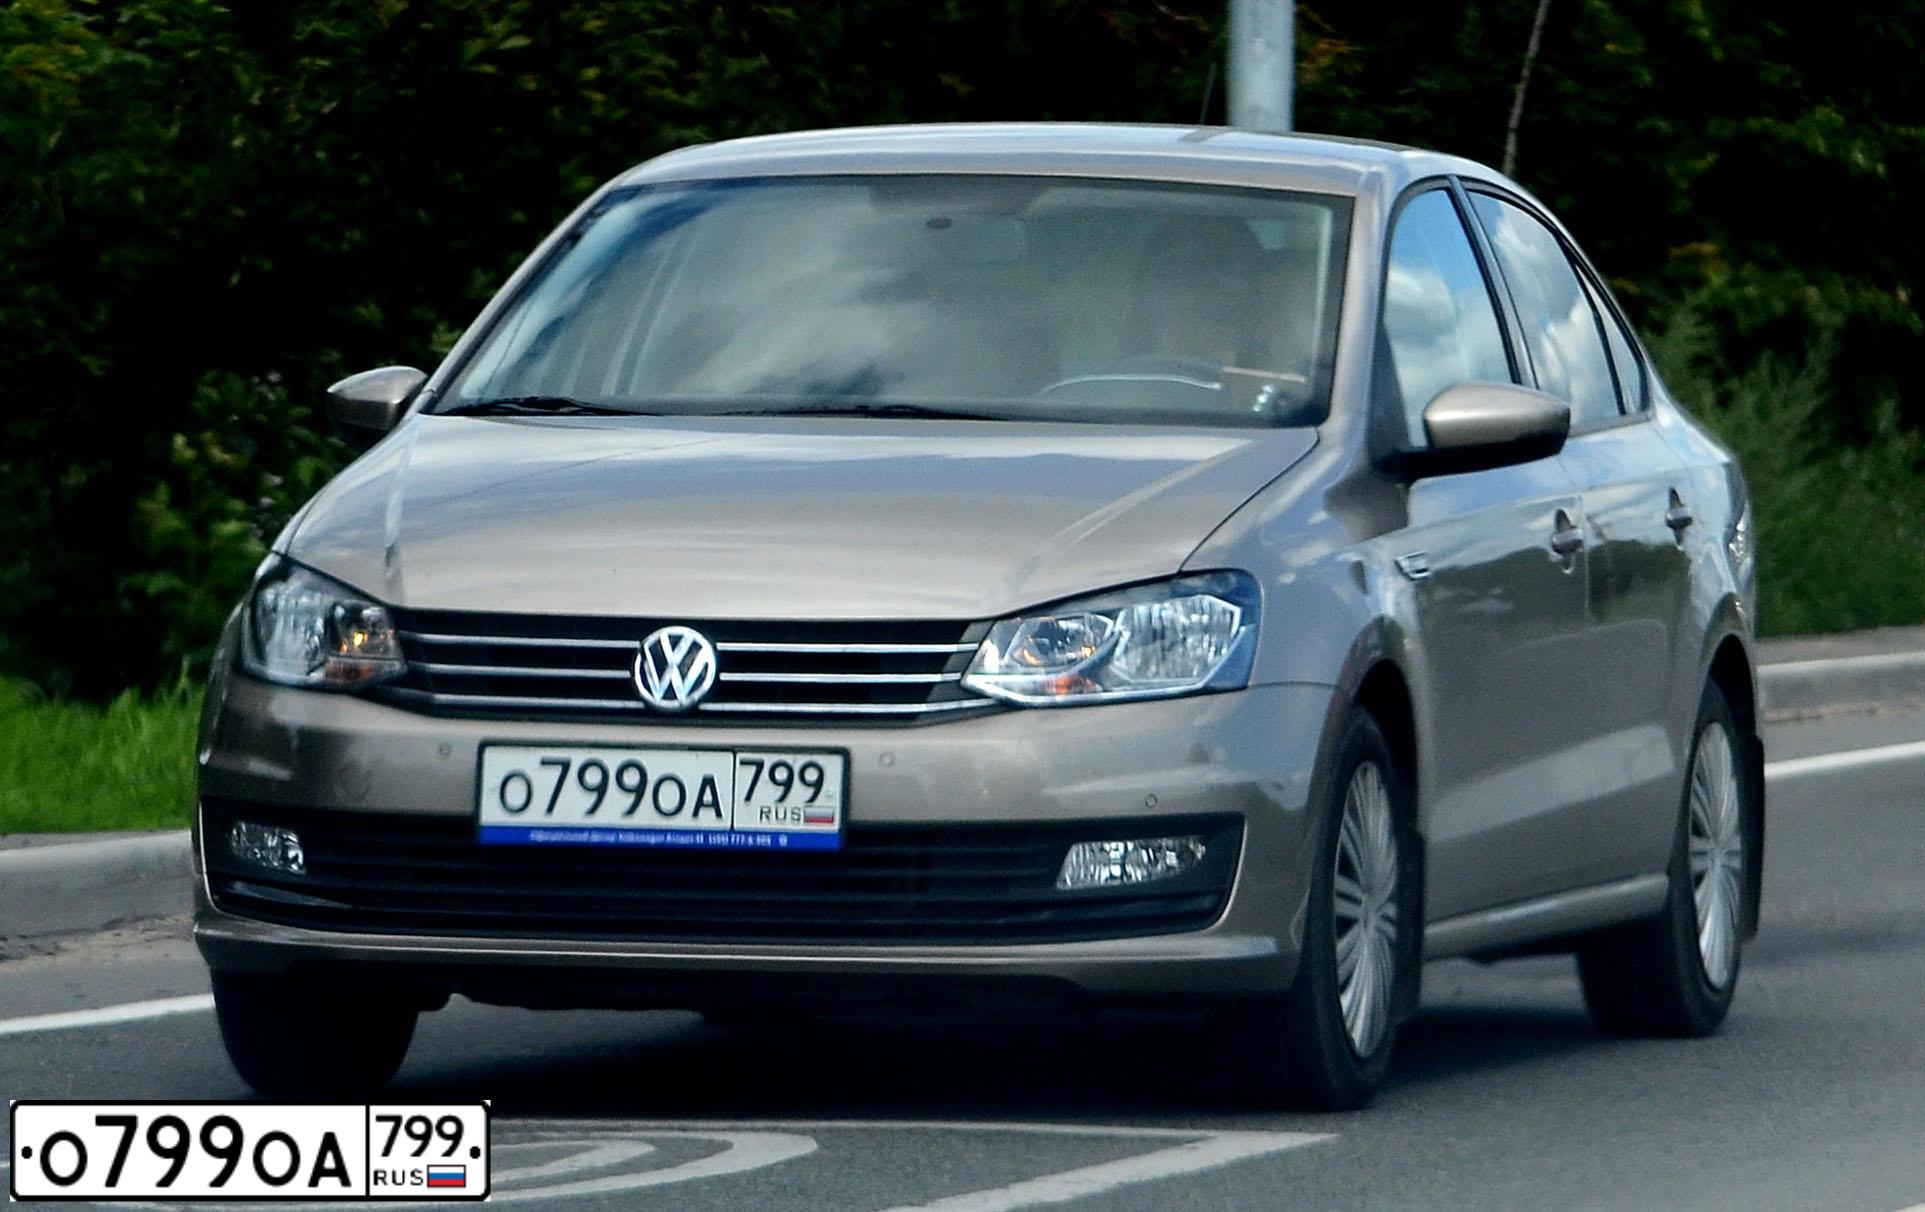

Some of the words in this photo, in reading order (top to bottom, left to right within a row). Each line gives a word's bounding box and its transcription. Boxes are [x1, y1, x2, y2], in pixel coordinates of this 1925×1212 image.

[499, 757, 724, 819] O799OA
[738, 758, 826, 804] 799
[759, 805, 802, 822] RUS
